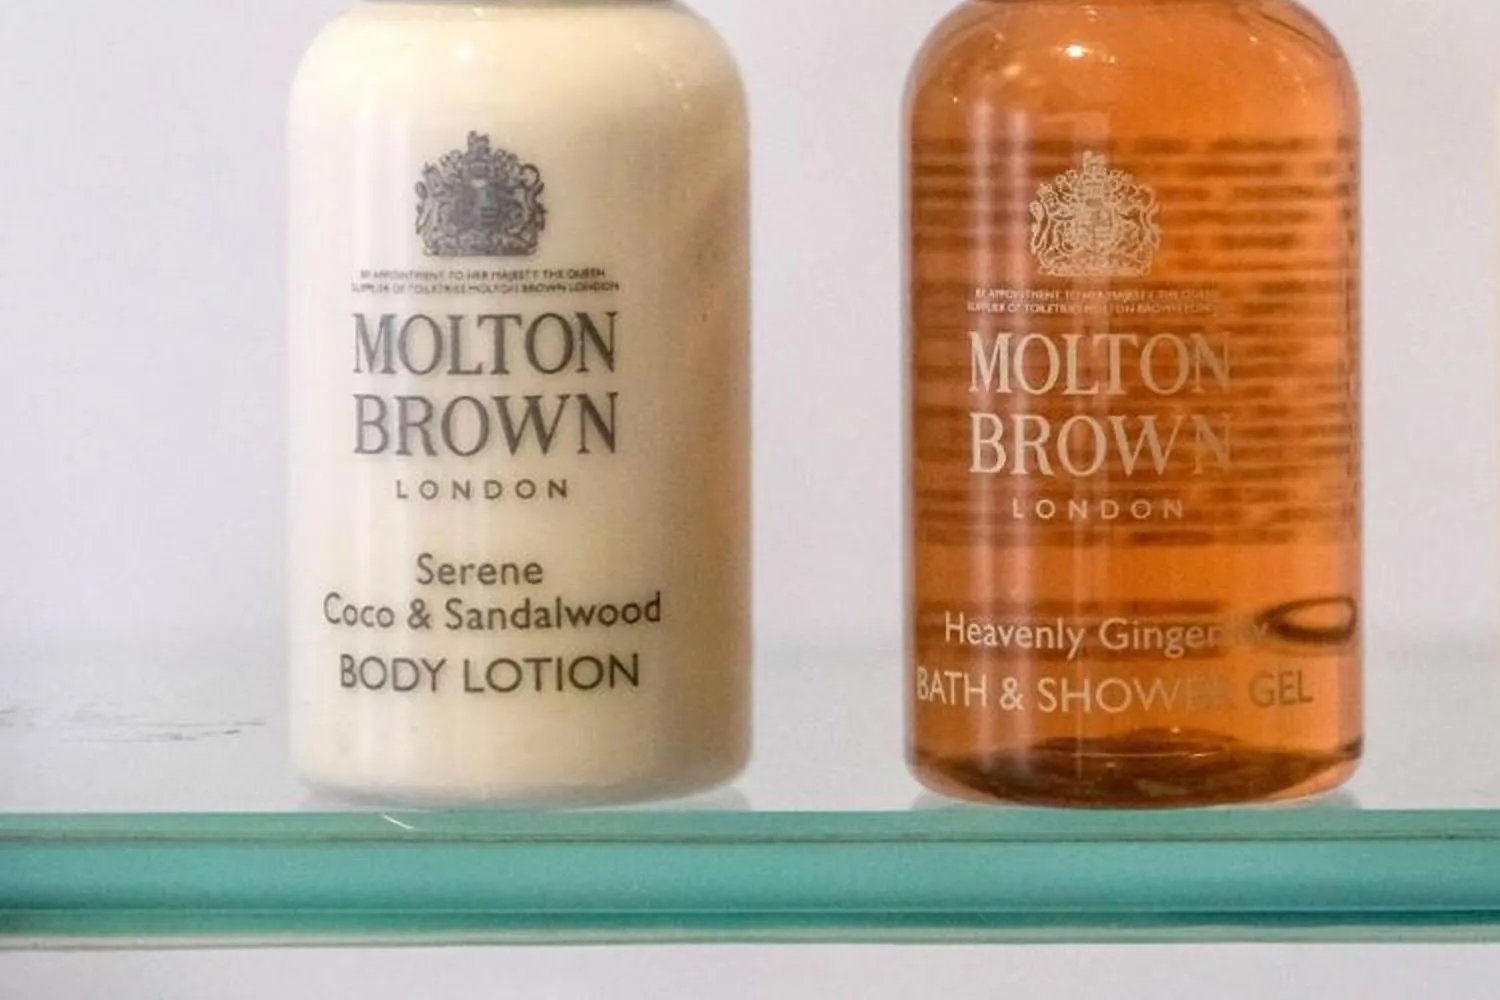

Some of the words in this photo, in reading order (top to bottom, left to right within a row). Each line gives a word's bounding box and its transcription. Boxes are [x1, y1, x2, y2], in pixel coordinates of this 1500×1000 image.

[352, 311, 619, 376] MOLTON
[967, 330, 1233, 395] MOLTON
[352, 392, 619, 457] BROWN
[967, 411, 1232, 477] BROWN
[395, 478, 569, 500] LONDON
[1011, 498, 1184, 521] LONDON
[415, 553, 544, 586] Serene
[323, 592, 395, 628] Coco
[406, 597, 432, 630] &
[444, 591, 662, 631] Sandalwood
[944, 610, 1086, 660] Heavenly
[339, 653, 447, 694] BODY
[462, 652, 640, 694] LOTION
[916, 666, 988, 709] BATH
[1000, 677, 1025, 712] &
[1036, 674, 1234, 714] SHOWE
[1247, 667, 1315, 709] GEL
